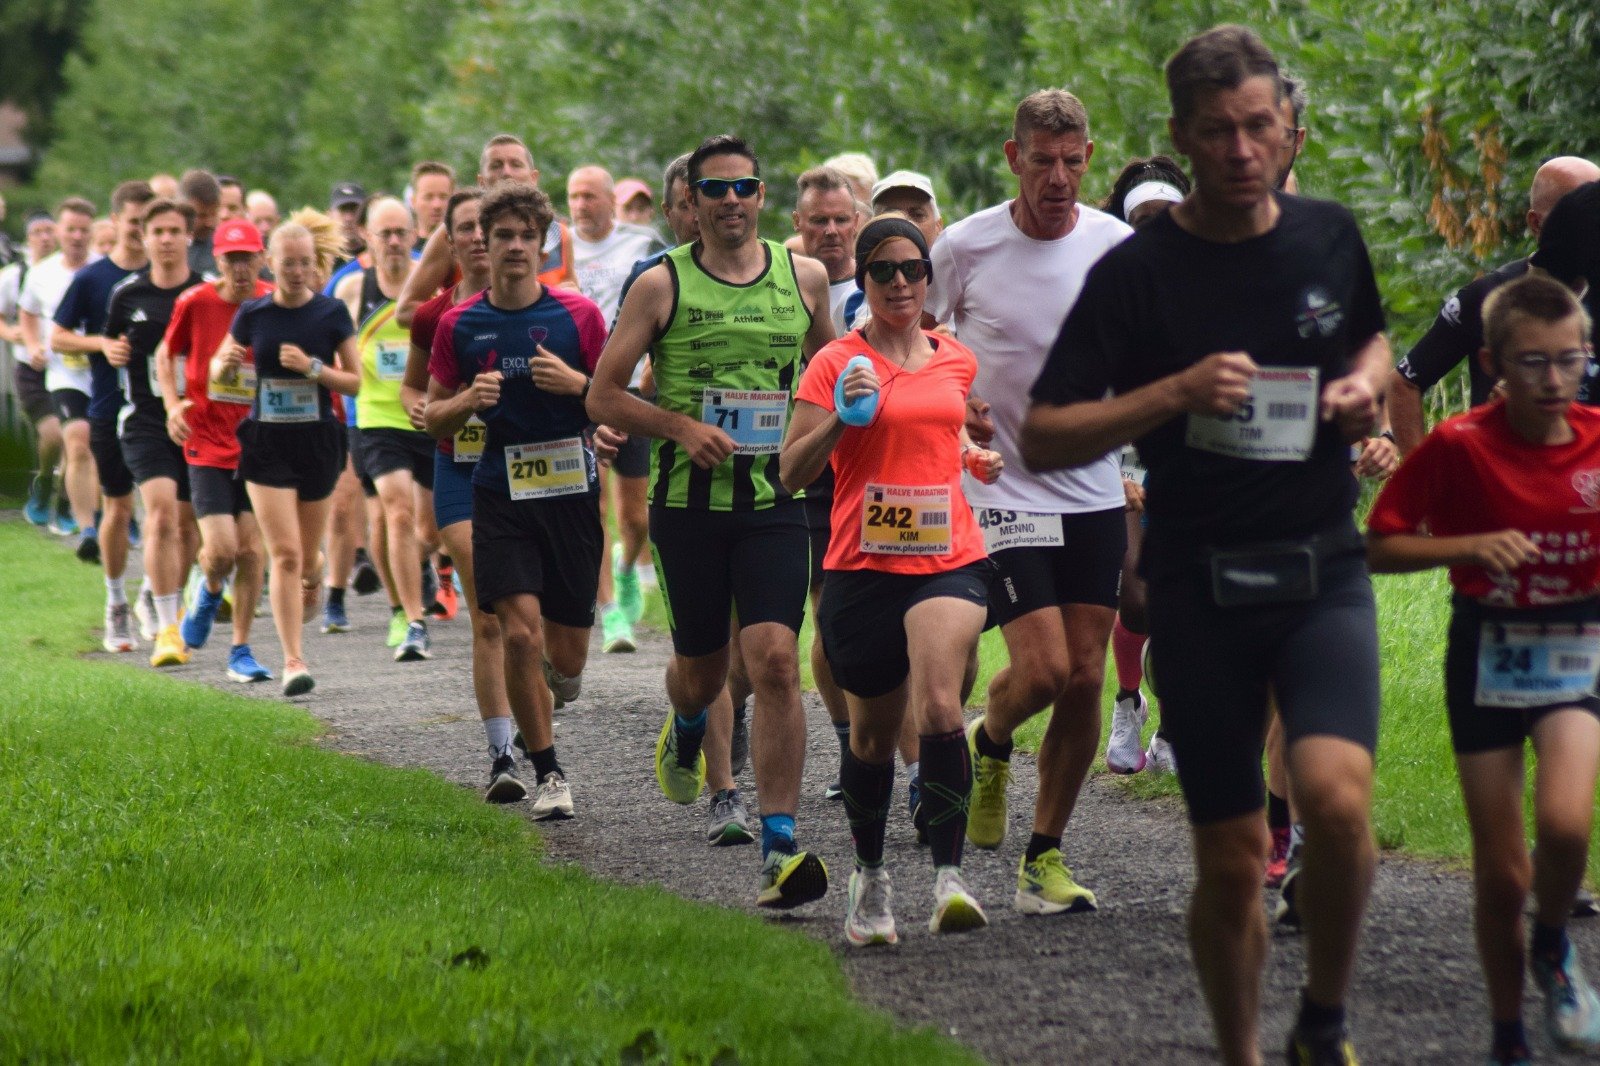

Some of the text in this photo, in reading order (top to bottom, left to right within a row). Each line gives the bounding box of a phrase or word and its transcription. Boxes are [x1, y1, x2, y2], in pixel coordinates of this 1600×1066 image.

[733, 315, 765, 323] Athlex
[381, 352, 398, 366] 52
[268, 392, 283, 406] 21
[725, 392, 748, 400] HALVE
[749, 393, 787, 401] MARATHON
[714, 408, 739, 430] 71
[522, 444, 543, 453] HALVE
[544, 440, 579, 450] MARATHON
[511, 459, 548, 480] 270
[524, 484, 584, 497] www.plusprint.be
[886, 488, 912, 497] HALVE
[913, 488, 949, 497] MARATHON
[867, 505, 913, 528] 242
[978, 509, 1017, 530] 453
[899, 531, 919, 541] KIM
[1000, 523, 1035, 536] MENNO
[878, 543, 948, 553] www.plusprint.be
[991, 535, 1060, 549] www.plusprint.be
[1494, 646, 1533, 673] 24
